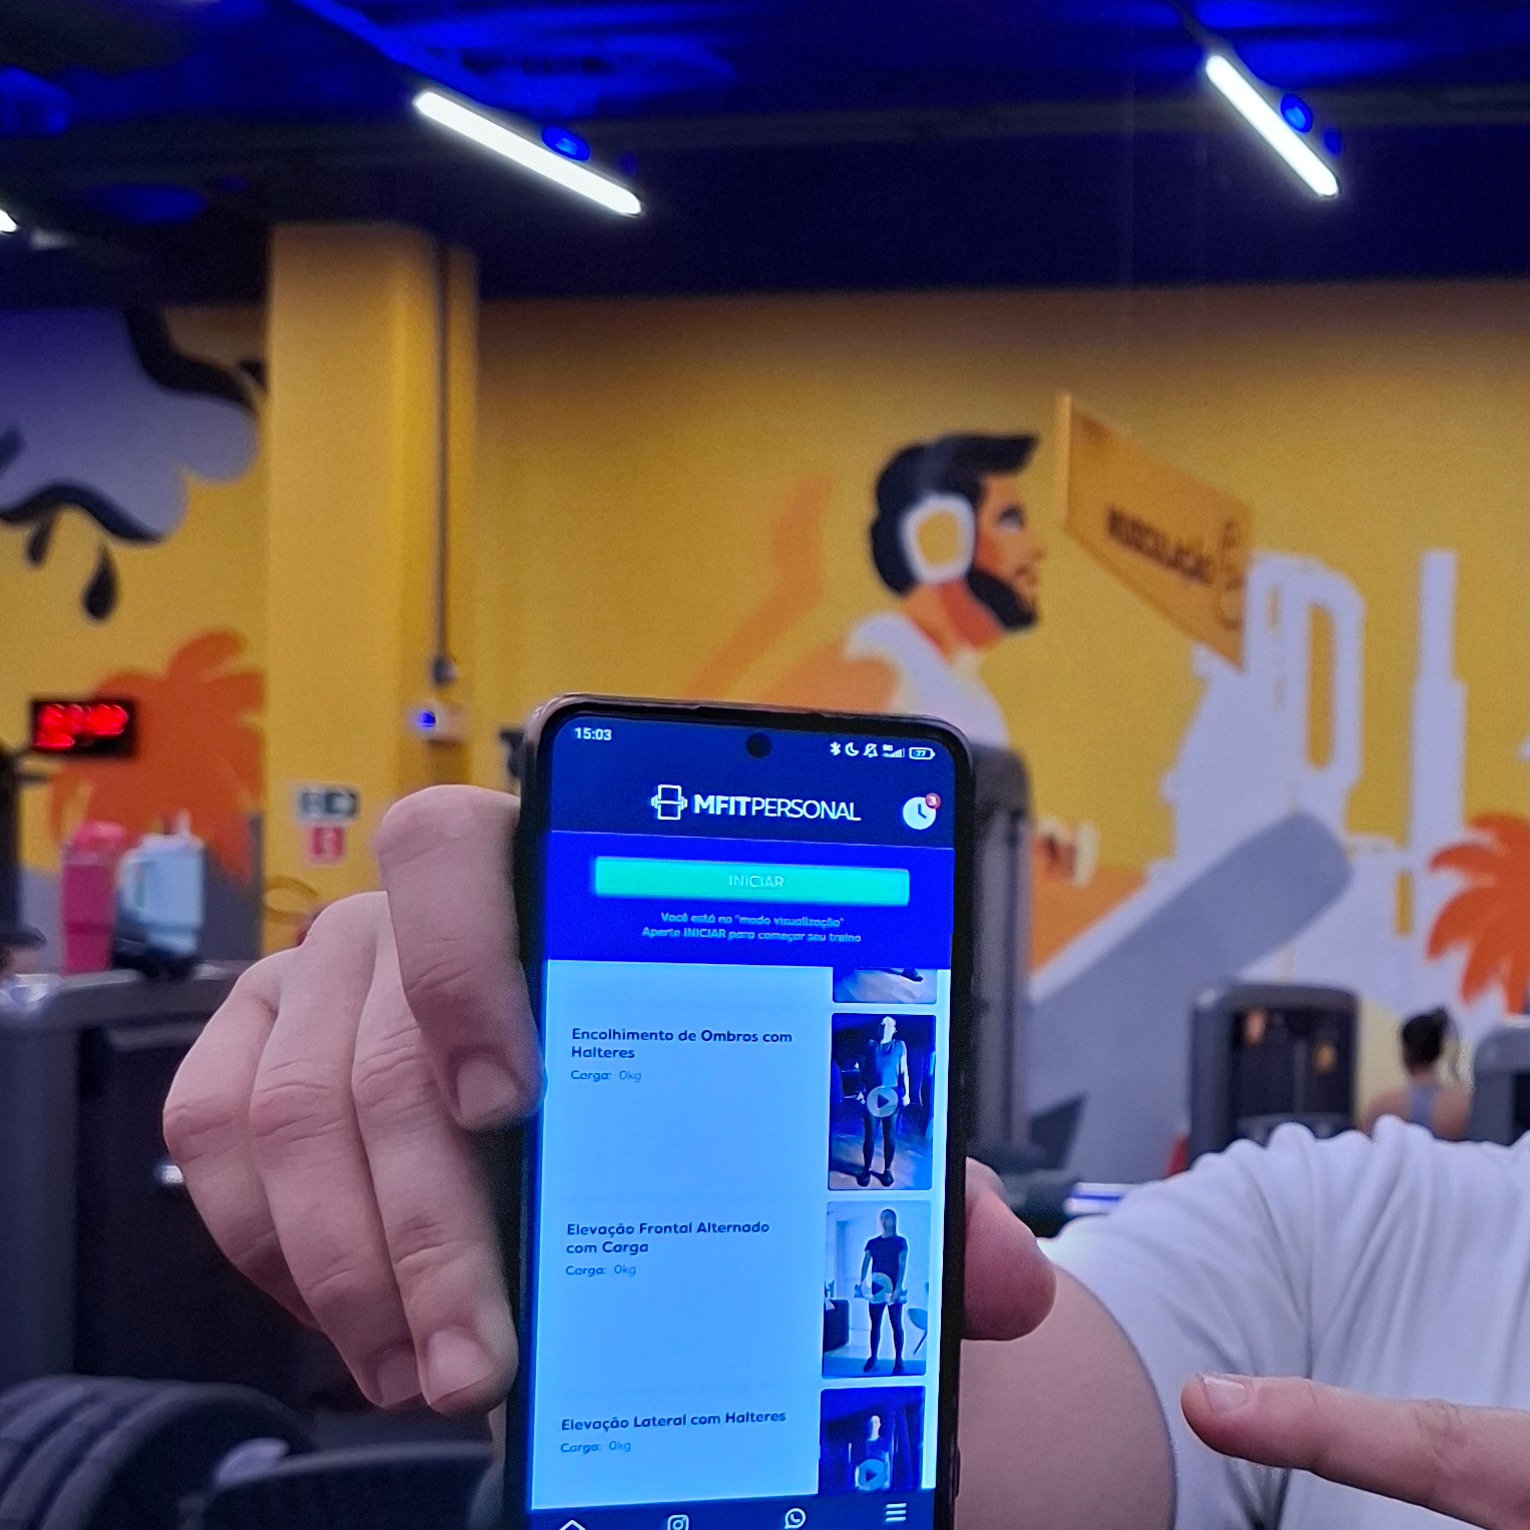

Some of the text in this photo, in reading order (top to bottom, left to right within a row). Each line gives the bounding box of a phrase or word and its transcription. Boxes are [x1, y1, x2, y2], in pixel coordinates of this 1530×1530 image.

[574, 726, 613, 741] 15:03
[728, 875, 785, 888] INICIAR
[660, 912, 688, 922] Você
[683, 927, 726, 938] INICIAR
[727, 931, 755, 941] para
[572, 1028, 793, 1043] Encolhimento de Ombros com
[571, 1046, 636, 1059] Halteres
[567, 1221, 770, 1238] Elevação Frontal Alternado
[566, 1241, 649, 1255] com Carga
[565, 1264, 637, 1278] Carga: 0kg
[561, 1411, 787, 1432] Elevação Lateral com Halteres
[560, 1441, 602, 1454] Carga:
